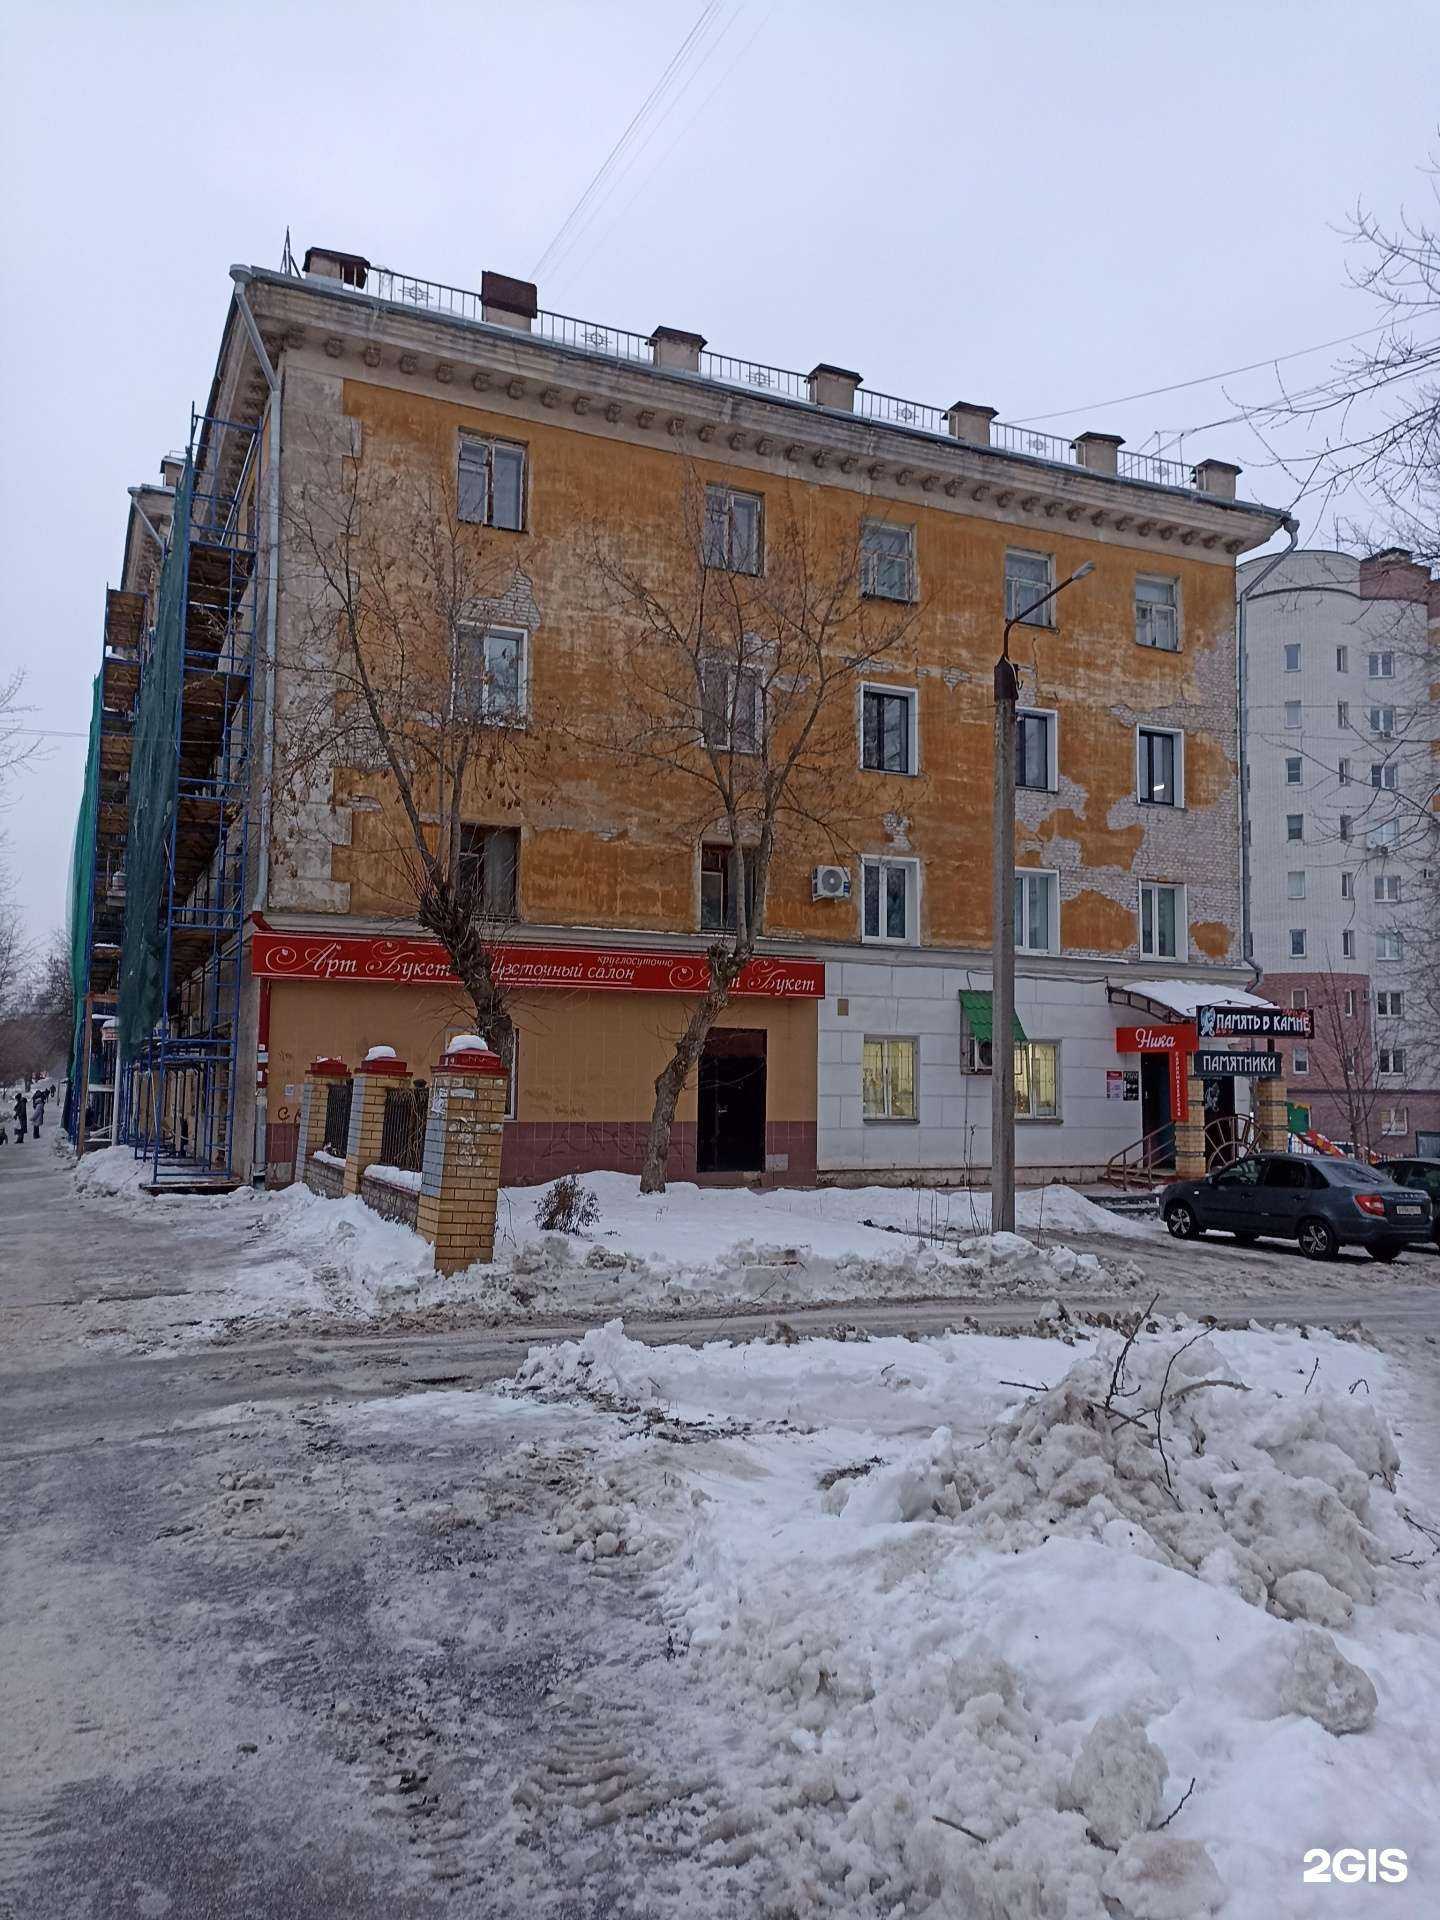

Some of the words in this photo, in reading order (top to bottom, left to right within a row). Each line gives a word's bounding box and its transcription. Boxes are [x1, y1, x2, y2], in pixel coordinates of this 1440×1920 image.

[266, 943, 356, 977] Арт
[366, 941, 452, 981] Букет
[490, 955, 583, 979] Цветочный
[587, 967, 635, 980] салон
[597, 956, 674, 968] круглосуточно
[747, 960, 815, 995] Букет
[1216, 1014, 1261, 1030] ПАМЯТЬ
[1263, 1015, 1271, 1030] В
[1273, 1016, 1312, 1031] КАМНЕ
[1135, 1028, 1175, 1048] Ника
[1203, 1056, 1276, 1072] ПАМЯТНИКИ
